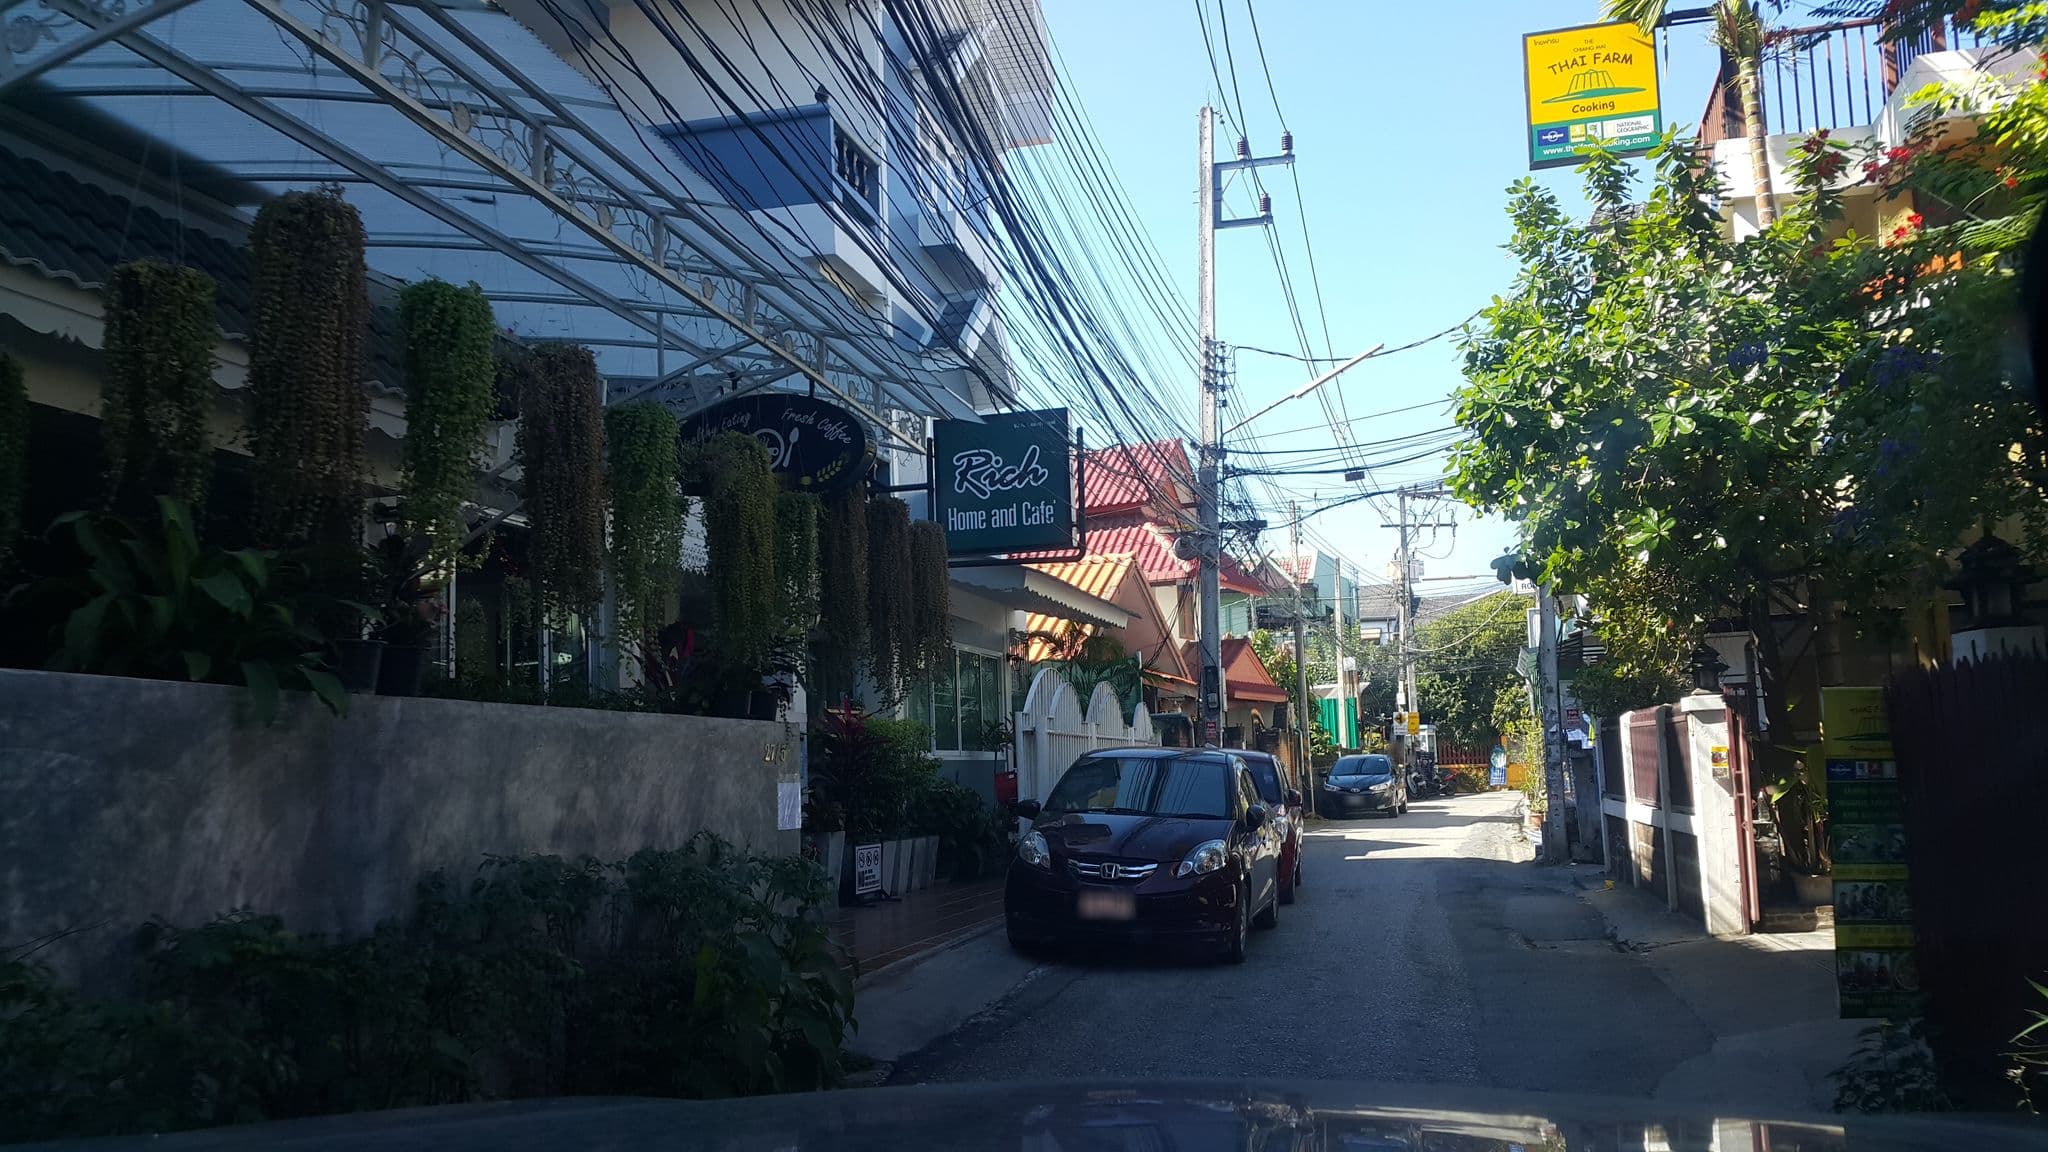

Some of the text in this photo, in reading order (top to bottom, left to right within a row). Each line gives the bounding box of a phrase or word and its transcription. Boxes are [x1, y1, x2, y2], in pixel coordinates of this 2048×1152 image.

[1547, 52, 1633, 75] THAI FARM
[1571, 101, 1616, 113] Cooking
[1616, 120, 1643, 128] NATIONAL
[1616, 124, 1650, 133] GEOGRAPHIC
[721, 411, 752, 430] Eating
[780, 408, 852, 444] Fresh Coffee
[952, 444, 1049, 500] Rich
[947, 507, 987, 531] Home
[991, 503, 1017, 528] and
